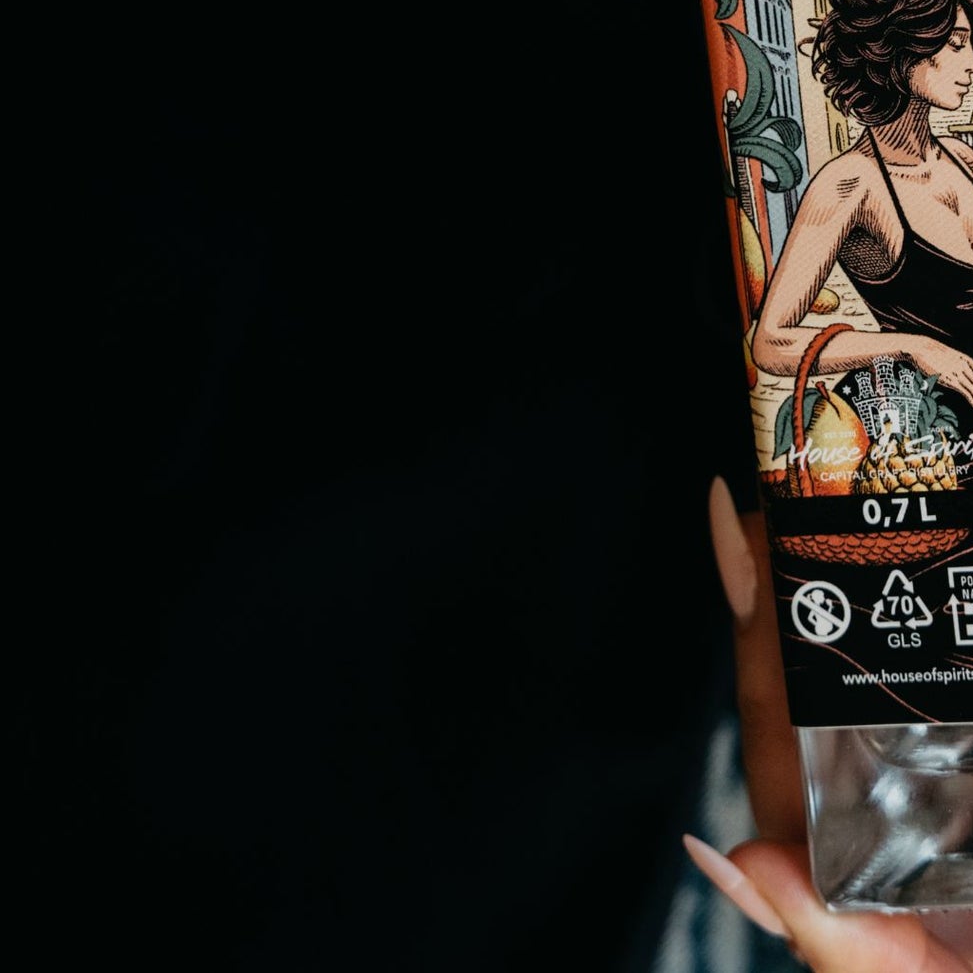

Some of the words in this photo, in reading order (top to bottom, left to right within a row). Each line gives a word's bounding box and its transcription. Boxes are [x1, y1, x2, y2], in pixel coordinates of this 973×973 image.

[788, 436, 863, 472] House
[862, 497, 909, 528] 0,7
[918, 496, 938, 523] L
[886, 595, 914, 616] 70
[887, 632, 923, 648] GLS
